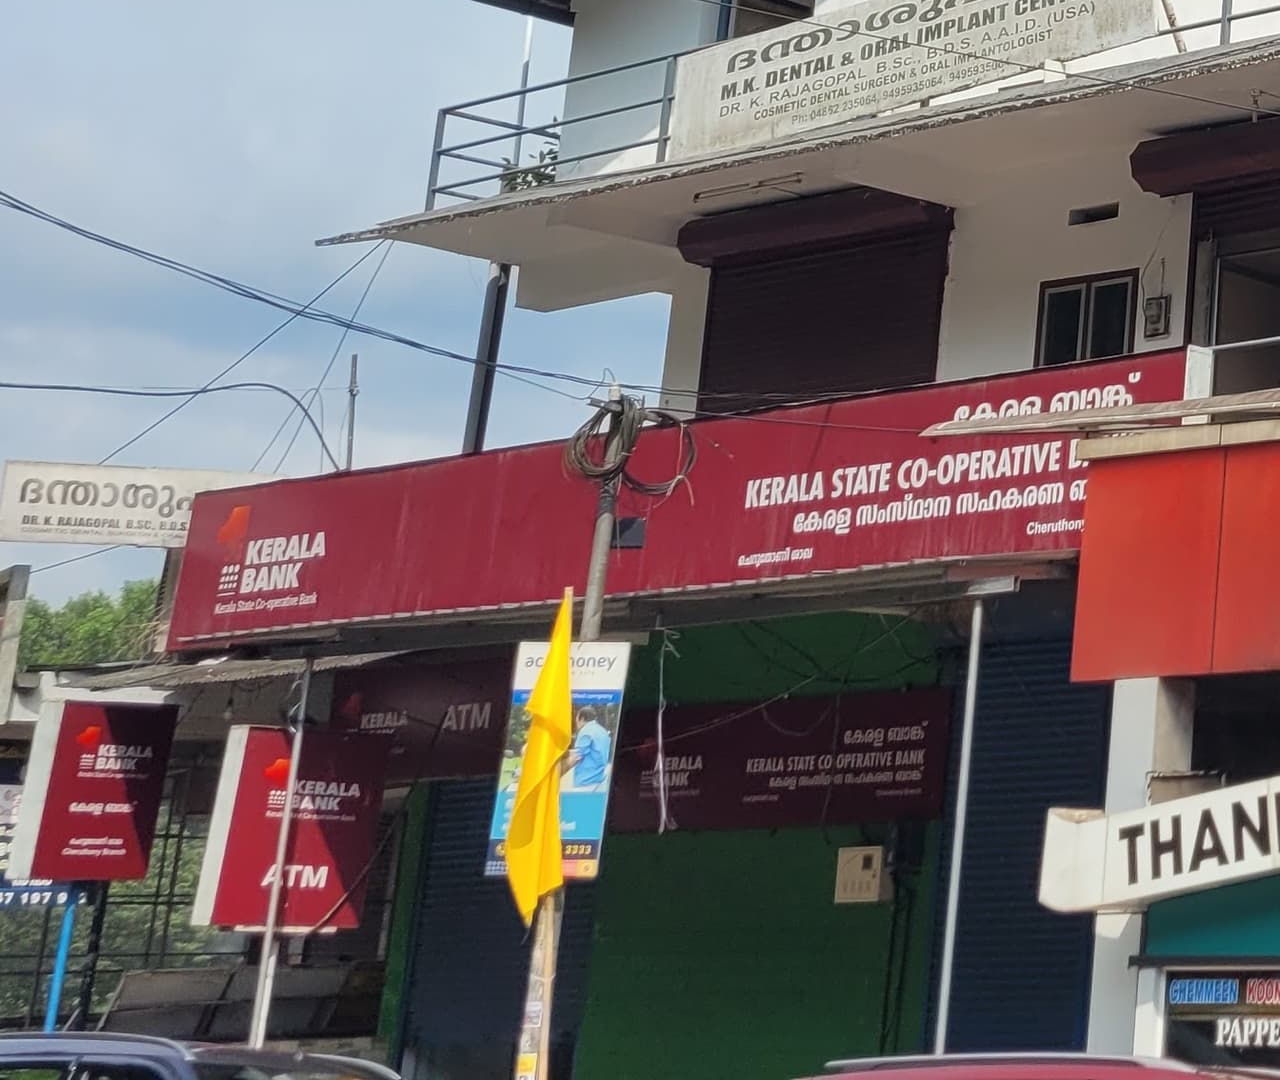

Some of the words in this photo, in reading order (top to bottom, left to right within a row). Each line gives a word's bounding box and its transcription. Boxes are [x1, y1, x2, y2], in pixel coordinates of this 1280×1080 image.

[719, 100, 744, 119] DR.
[750, 96, 766, 110] K.
[769, 70, 867, 105] RAJAGOPAL
[927, 37, 974, 60] B.D.S.
[980, 18, 1041, 47] A.A.I.D.
[1046, 0, 1096, 29] (USA)
[720, 78, 761, 101] M.K.
[766, 51, 835, 90] DENTAL
[841, 51, 855, 66] &
[860, 34, 911, 62] ORAL
[916, 3, 1009, 47] IMPLANT
[754, 100, 806, 121] COSMETIC
[810, 87, 850, 107] DENTAL
[854, 72, 907, 99] SURGEON
[909, 67, 918, 80] &
[921, 58, 950, 75] ORAL
[954, 29, 1054, 65] IMPLANTOLOGIST
[745, 471, 824, 510] KERALA
[830, 462, 892, 499] STATE
[897, 439, 1061, 491] CO-OPERATIVE
[58, 516, 120, 528] RAJAGOPAL
[793, 508, 851, 536] കേരള
[245, 531, 326, 565] KERALA
[240, 561, 303, 594] BANK
[361, 711, 408, 730] KERALA
[442, 701, 492, 731] ATM
[95, 757, 138, 771] BANK
[98, 744, 152, 759] KERALA
[746, 758, 785, 773] KERALA
[787, 755, 816, 771] STATE
[895, 749, 926, 766] BANK
[294, 780, 361, 798] KERALA
[261, 865, 328, 889] ATM
